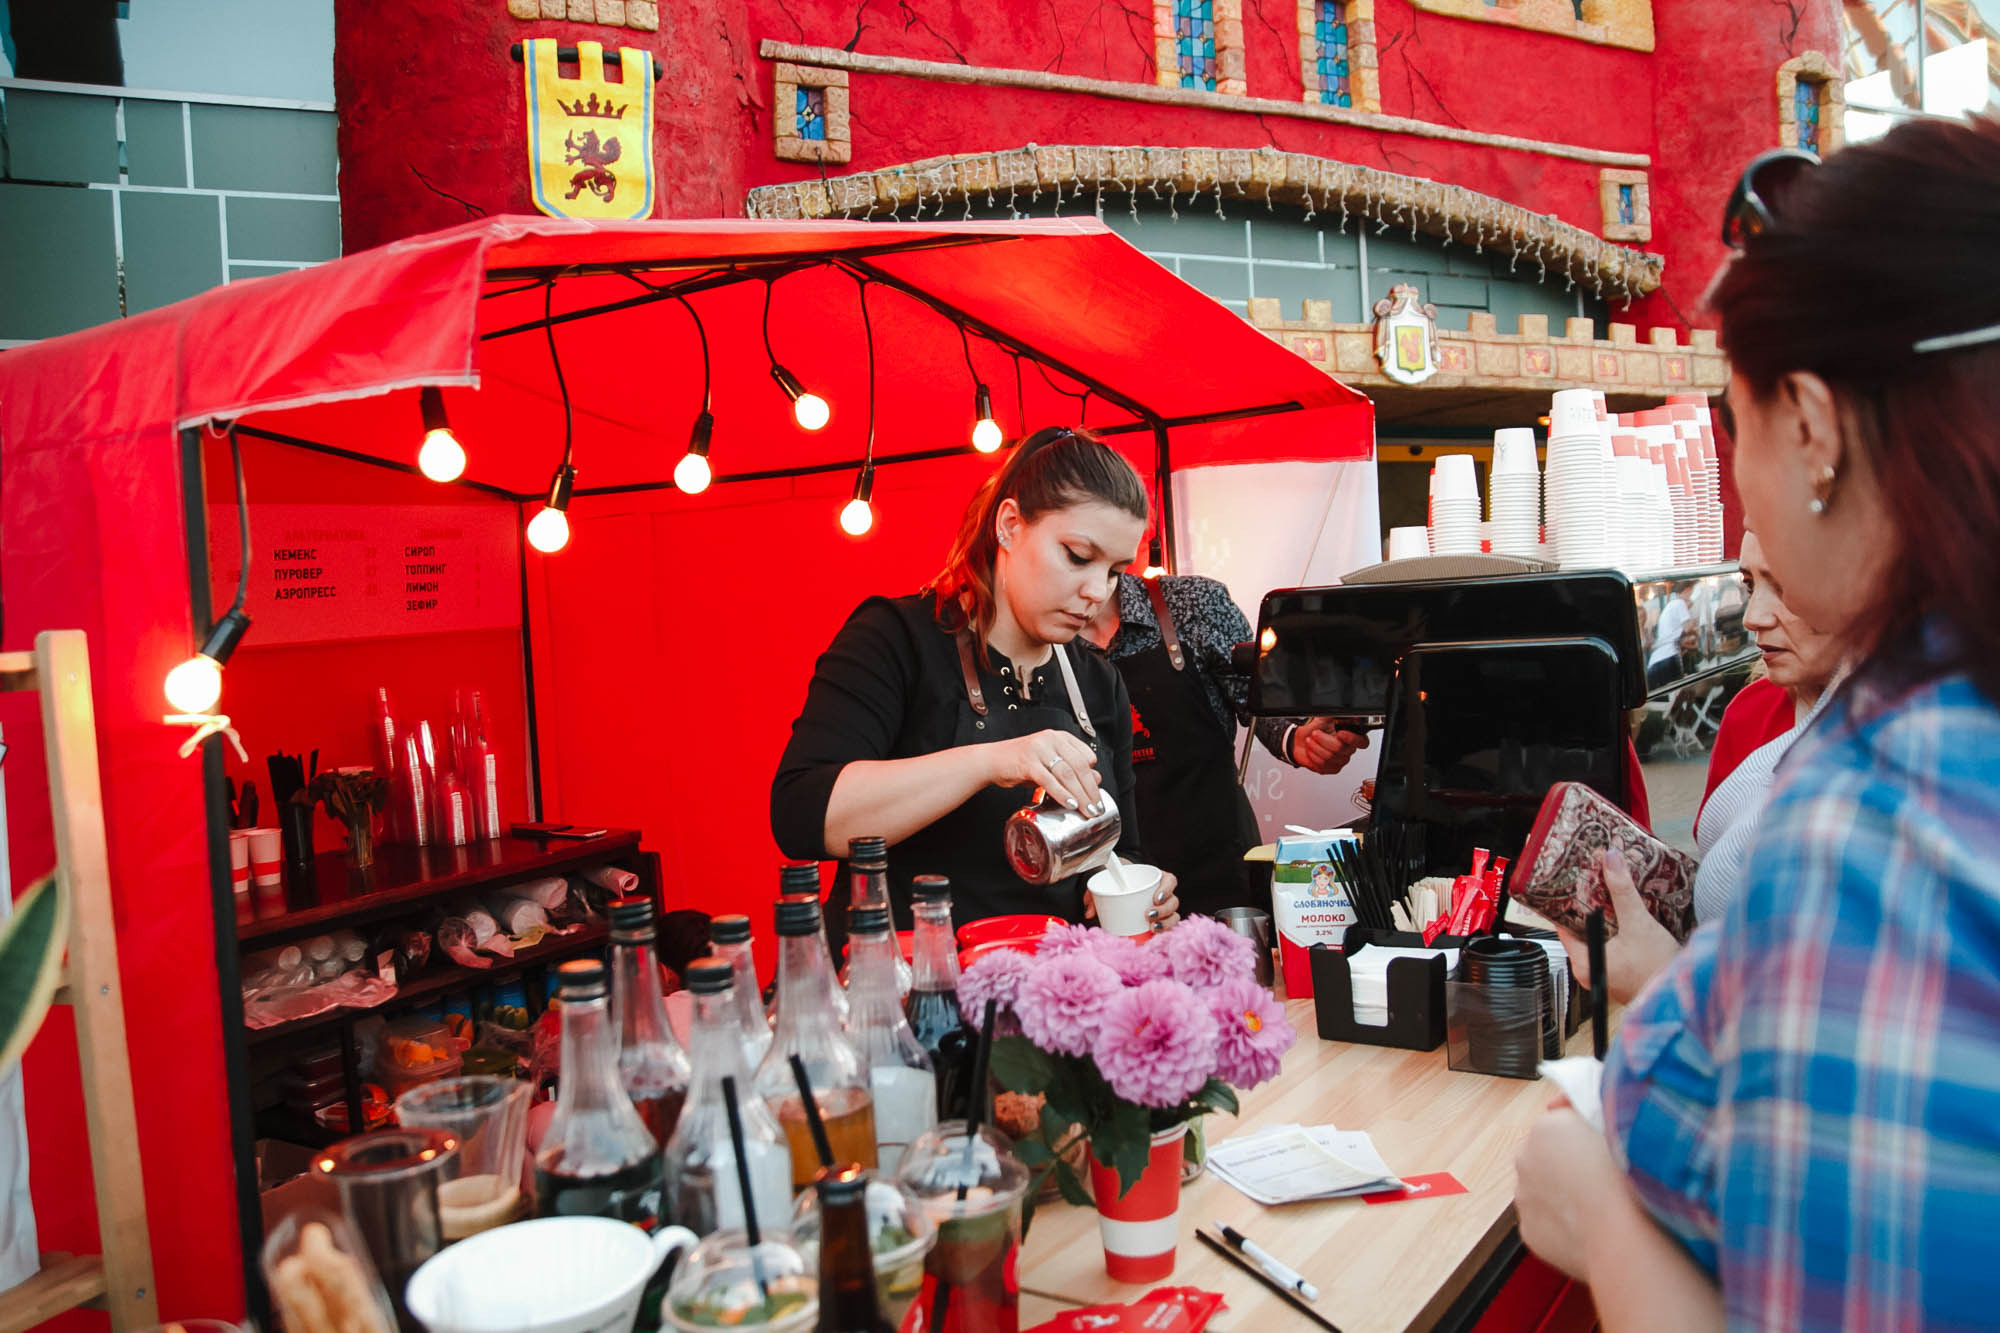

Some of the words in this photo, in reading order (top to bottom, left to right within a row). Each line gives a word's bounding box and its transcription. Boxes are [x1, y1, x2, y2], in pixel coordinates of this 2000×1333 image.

[273, 549, 317, 561] КЕМЕКС
[404, 546, 435, 557] СИРОП
[274, 567, 323, 580] ПУРОВЕР
[405, 563, 447, 576] ТОППИНГ
[275, 586, 336, 600] АЭРОПРЕСС
[406, 581, 439, 593] ЛИМОН
[406, 599, 438, 611] ЗЕФИР
[1301, 913, 1346, 923] МОЛОКО
